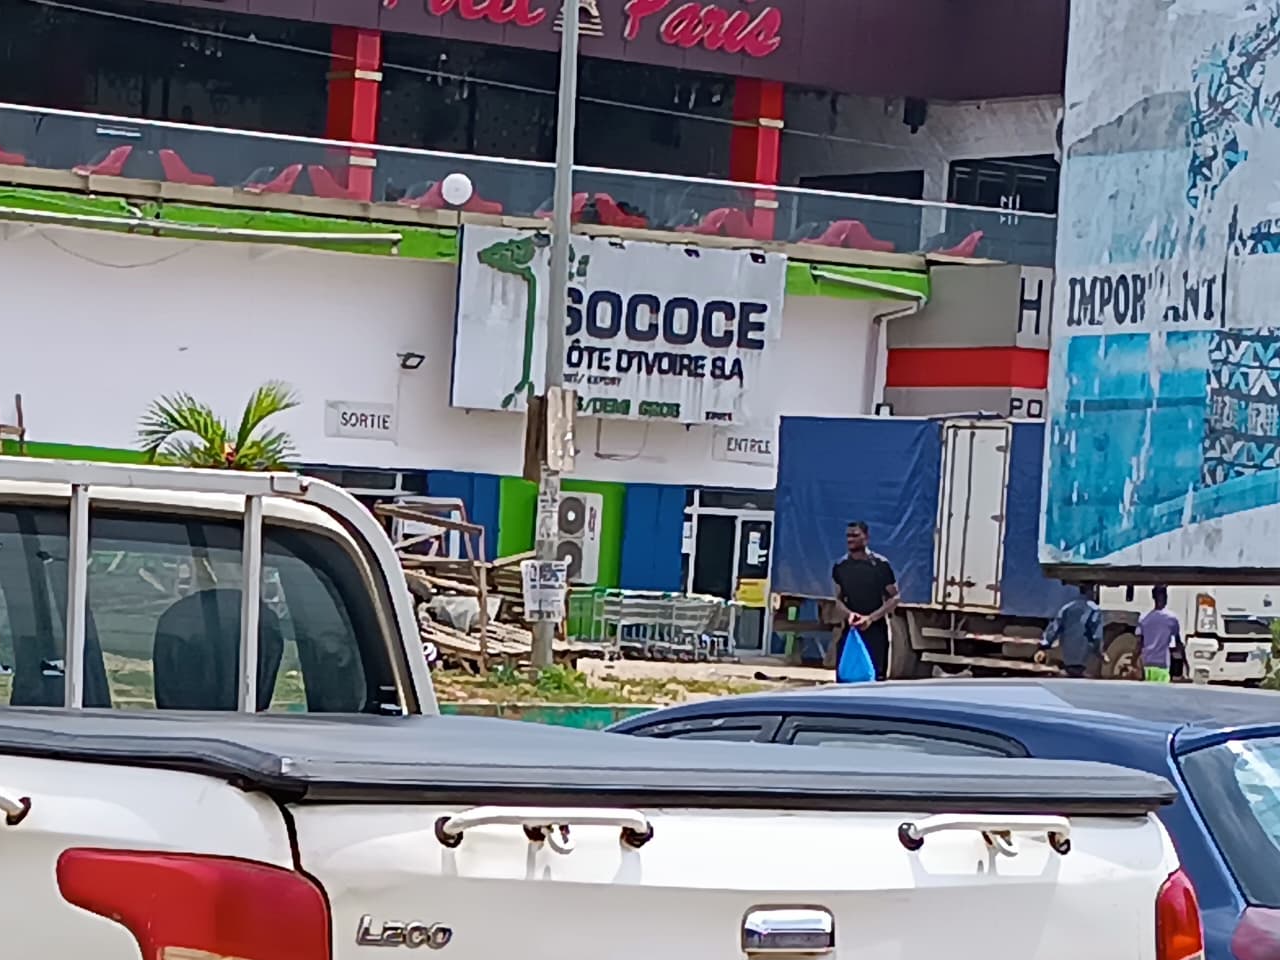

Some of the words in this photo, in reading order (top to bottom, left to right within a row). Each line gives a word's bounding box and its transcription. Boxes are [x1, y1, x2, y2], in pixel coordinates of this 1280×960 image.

[566, 286, 768, 350] SOCOCE
[1067, 271, 1217, 328] IMPORNT
[566, 340, 612, 371] ÔTE
[340, 411, 391, 430] SORTIE
